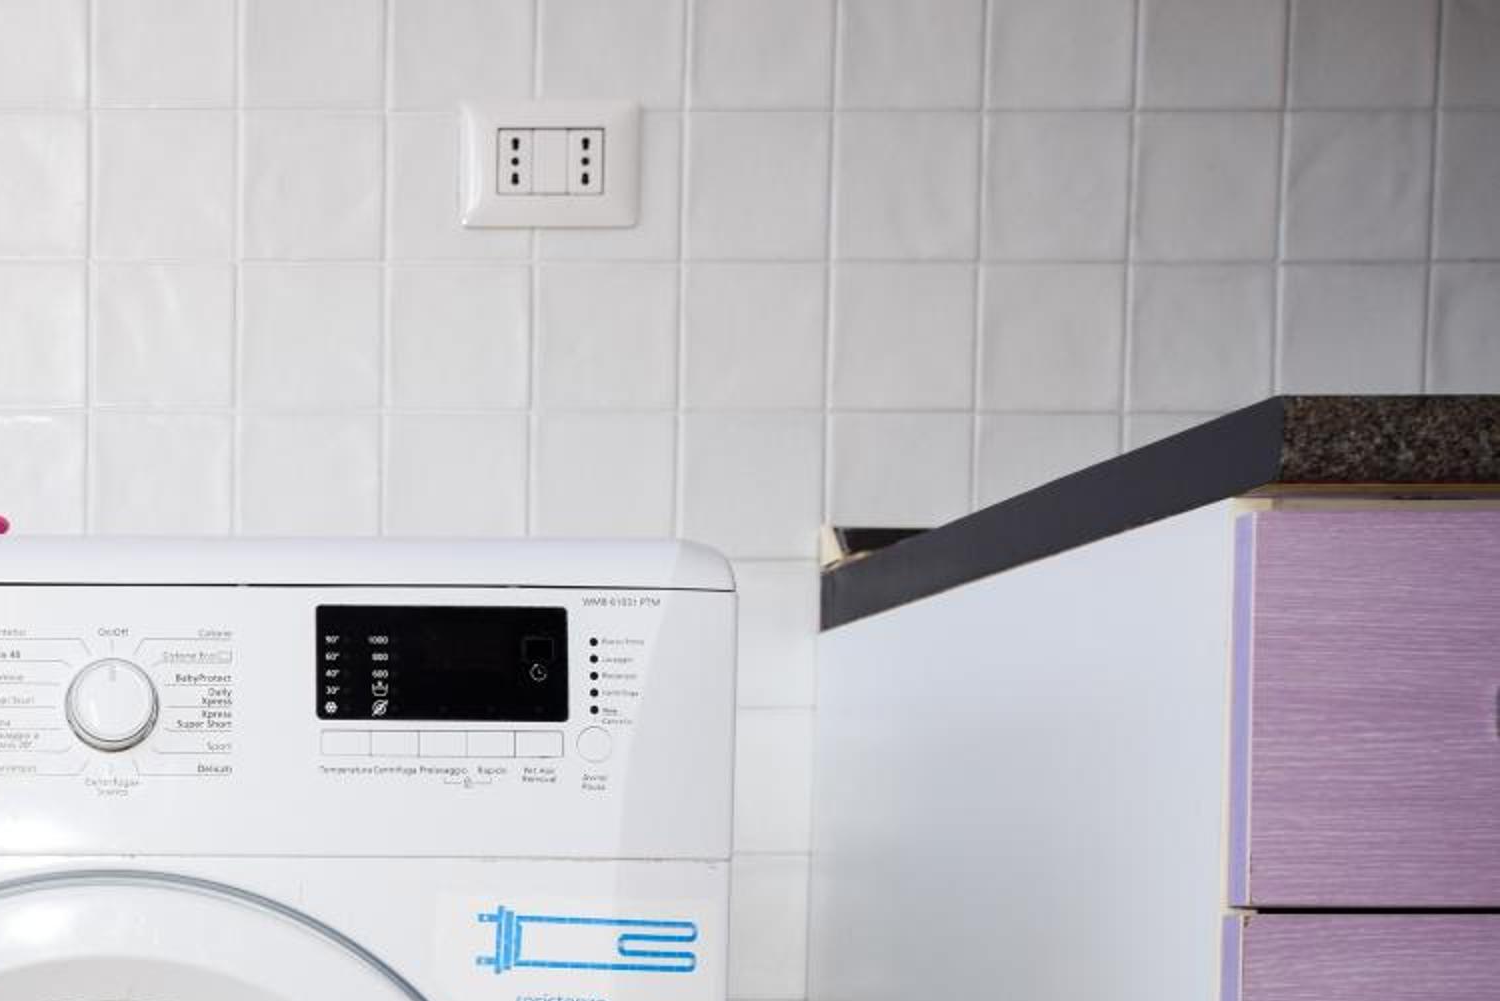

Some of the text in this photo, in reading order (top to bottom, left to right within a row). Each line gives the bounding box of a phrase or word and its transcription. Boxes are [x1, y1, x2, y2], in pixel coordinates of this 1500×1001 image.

[98, 628, 129, 638] On/Off
[202, 697, 233, 707] Xpress
[202, 710, 232, 720] Xpress
[207, 719, 232, 728] Short
